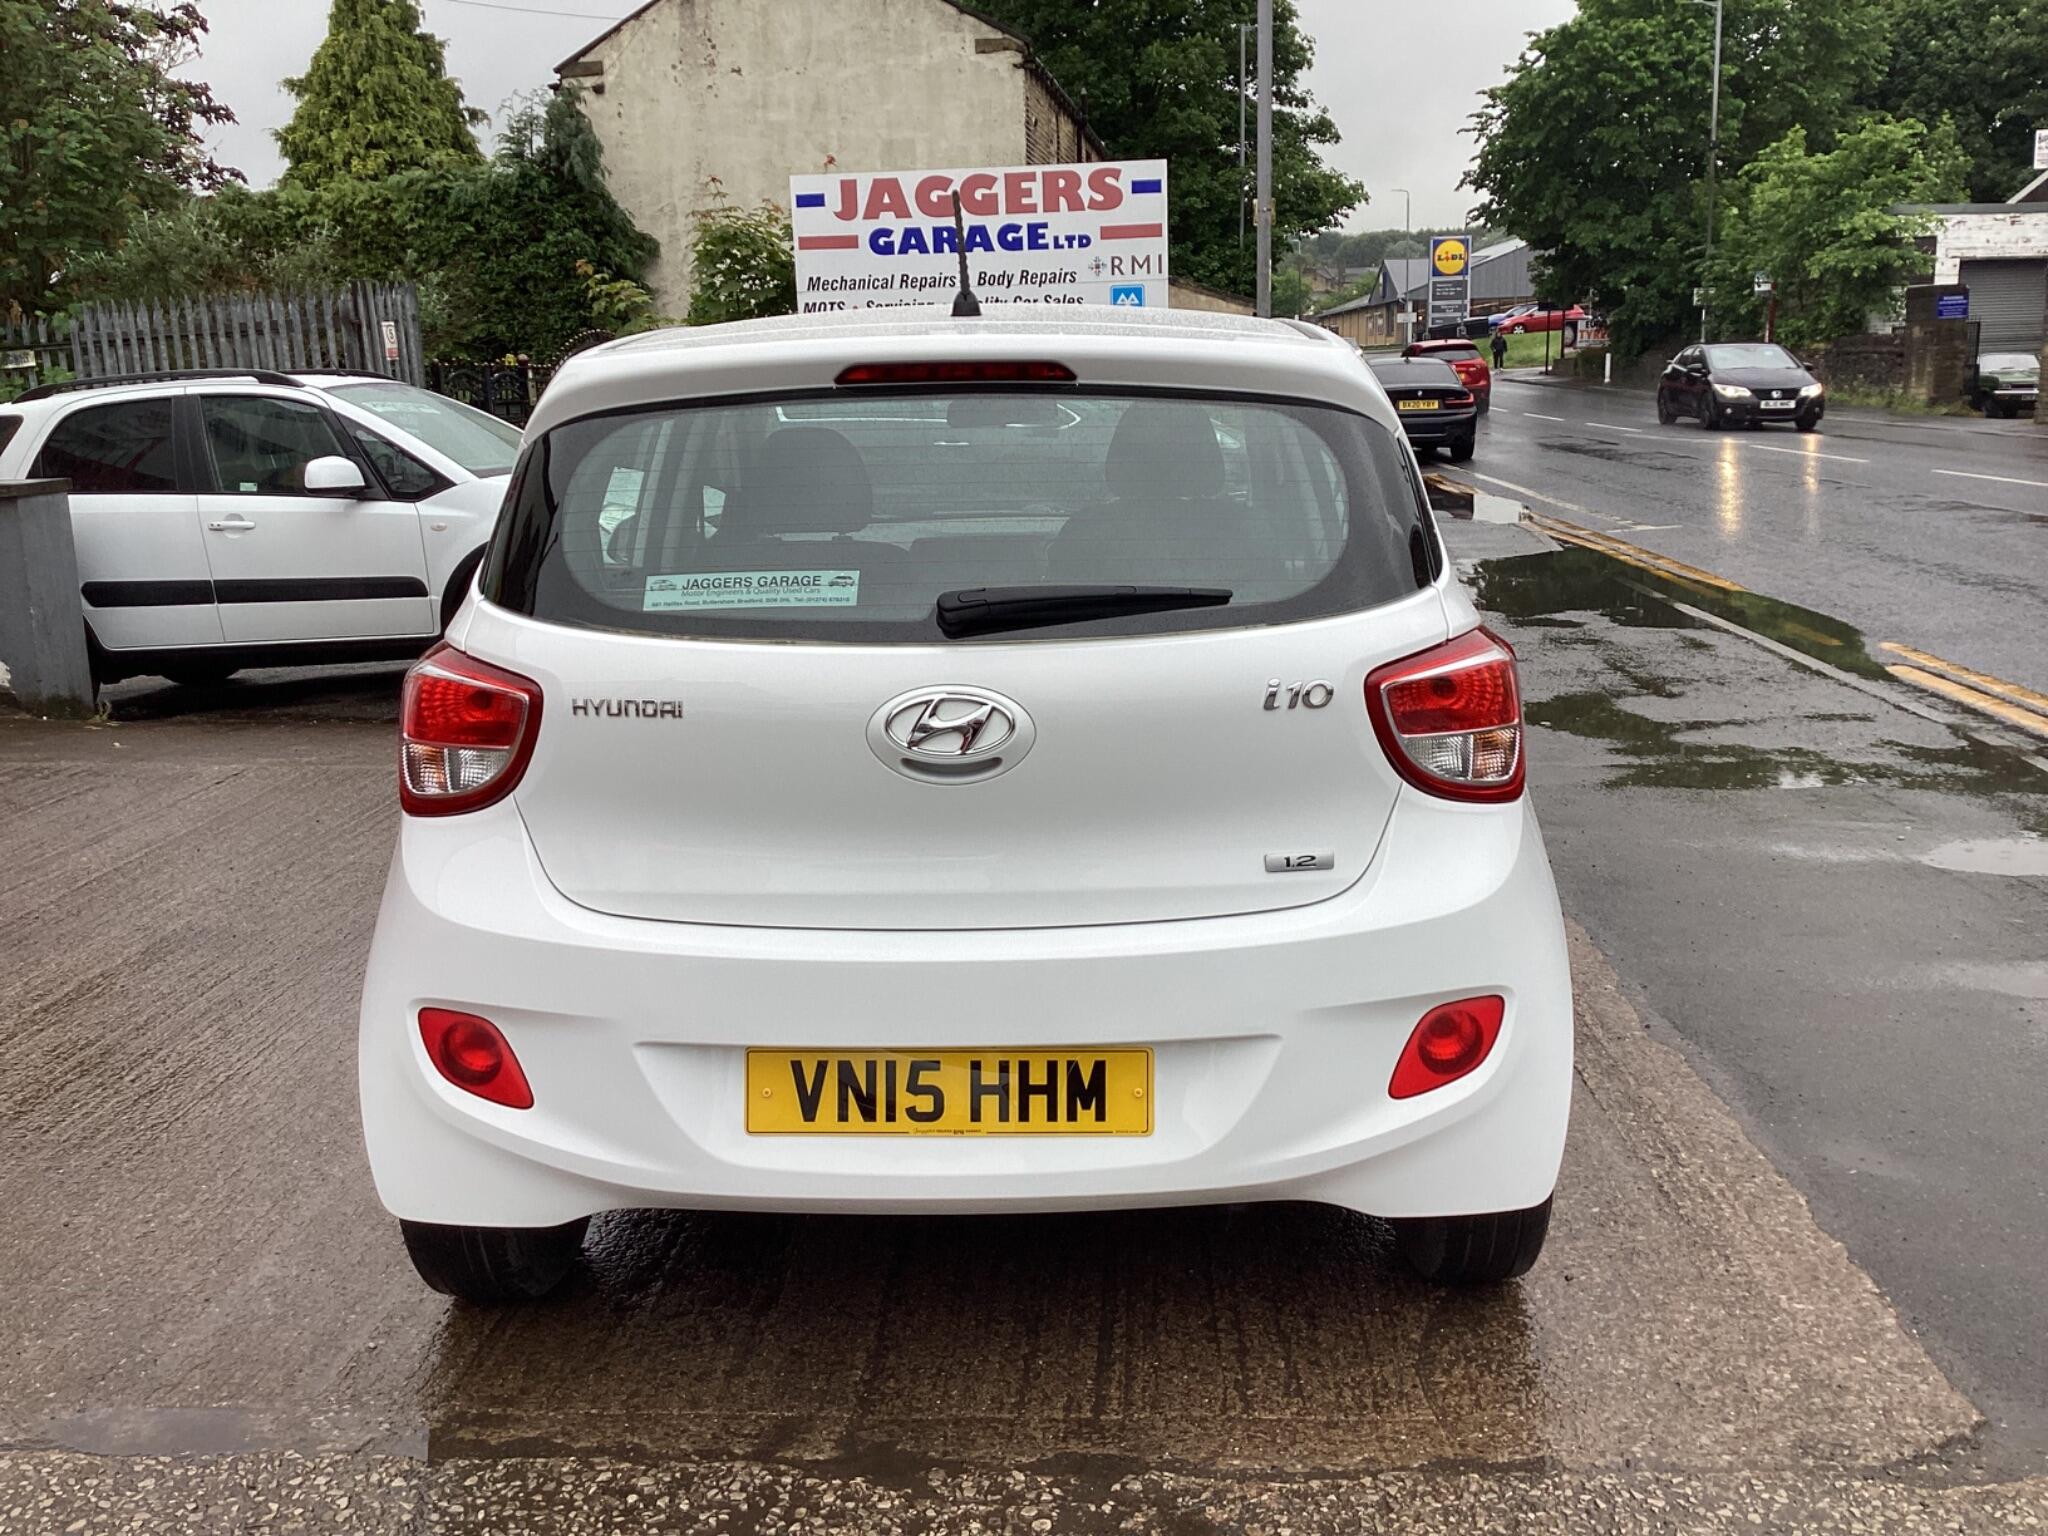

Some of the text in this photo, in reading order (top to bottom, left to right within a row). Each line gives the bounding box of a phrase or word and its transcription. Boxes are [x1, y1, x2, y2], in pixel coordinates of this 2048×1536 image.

[833, 168, 1124, 221] JAGGERS
[868, 222, 1092, 256] GARAGE LTD
[1110, 254, 1163, 276] RMI
[806, 268, 1078, 292] Mechanical Repairs Body Repairs
[681, 575, 822, 591] JAGGERS GARAGE
[706, 588, 744, 598] Engineers
[753, 586, 780, 596] Quality
[783, 586, 802, 594] Used
[804, 585, 821, 593] Cars
[1263, 678, 1335, 711] i10
[572, 698, 683, 719] HYUNDAI
[1284, 855, 1318, 868] 1.2
[790, 1059, 1107, 1123] VN15 HHM
